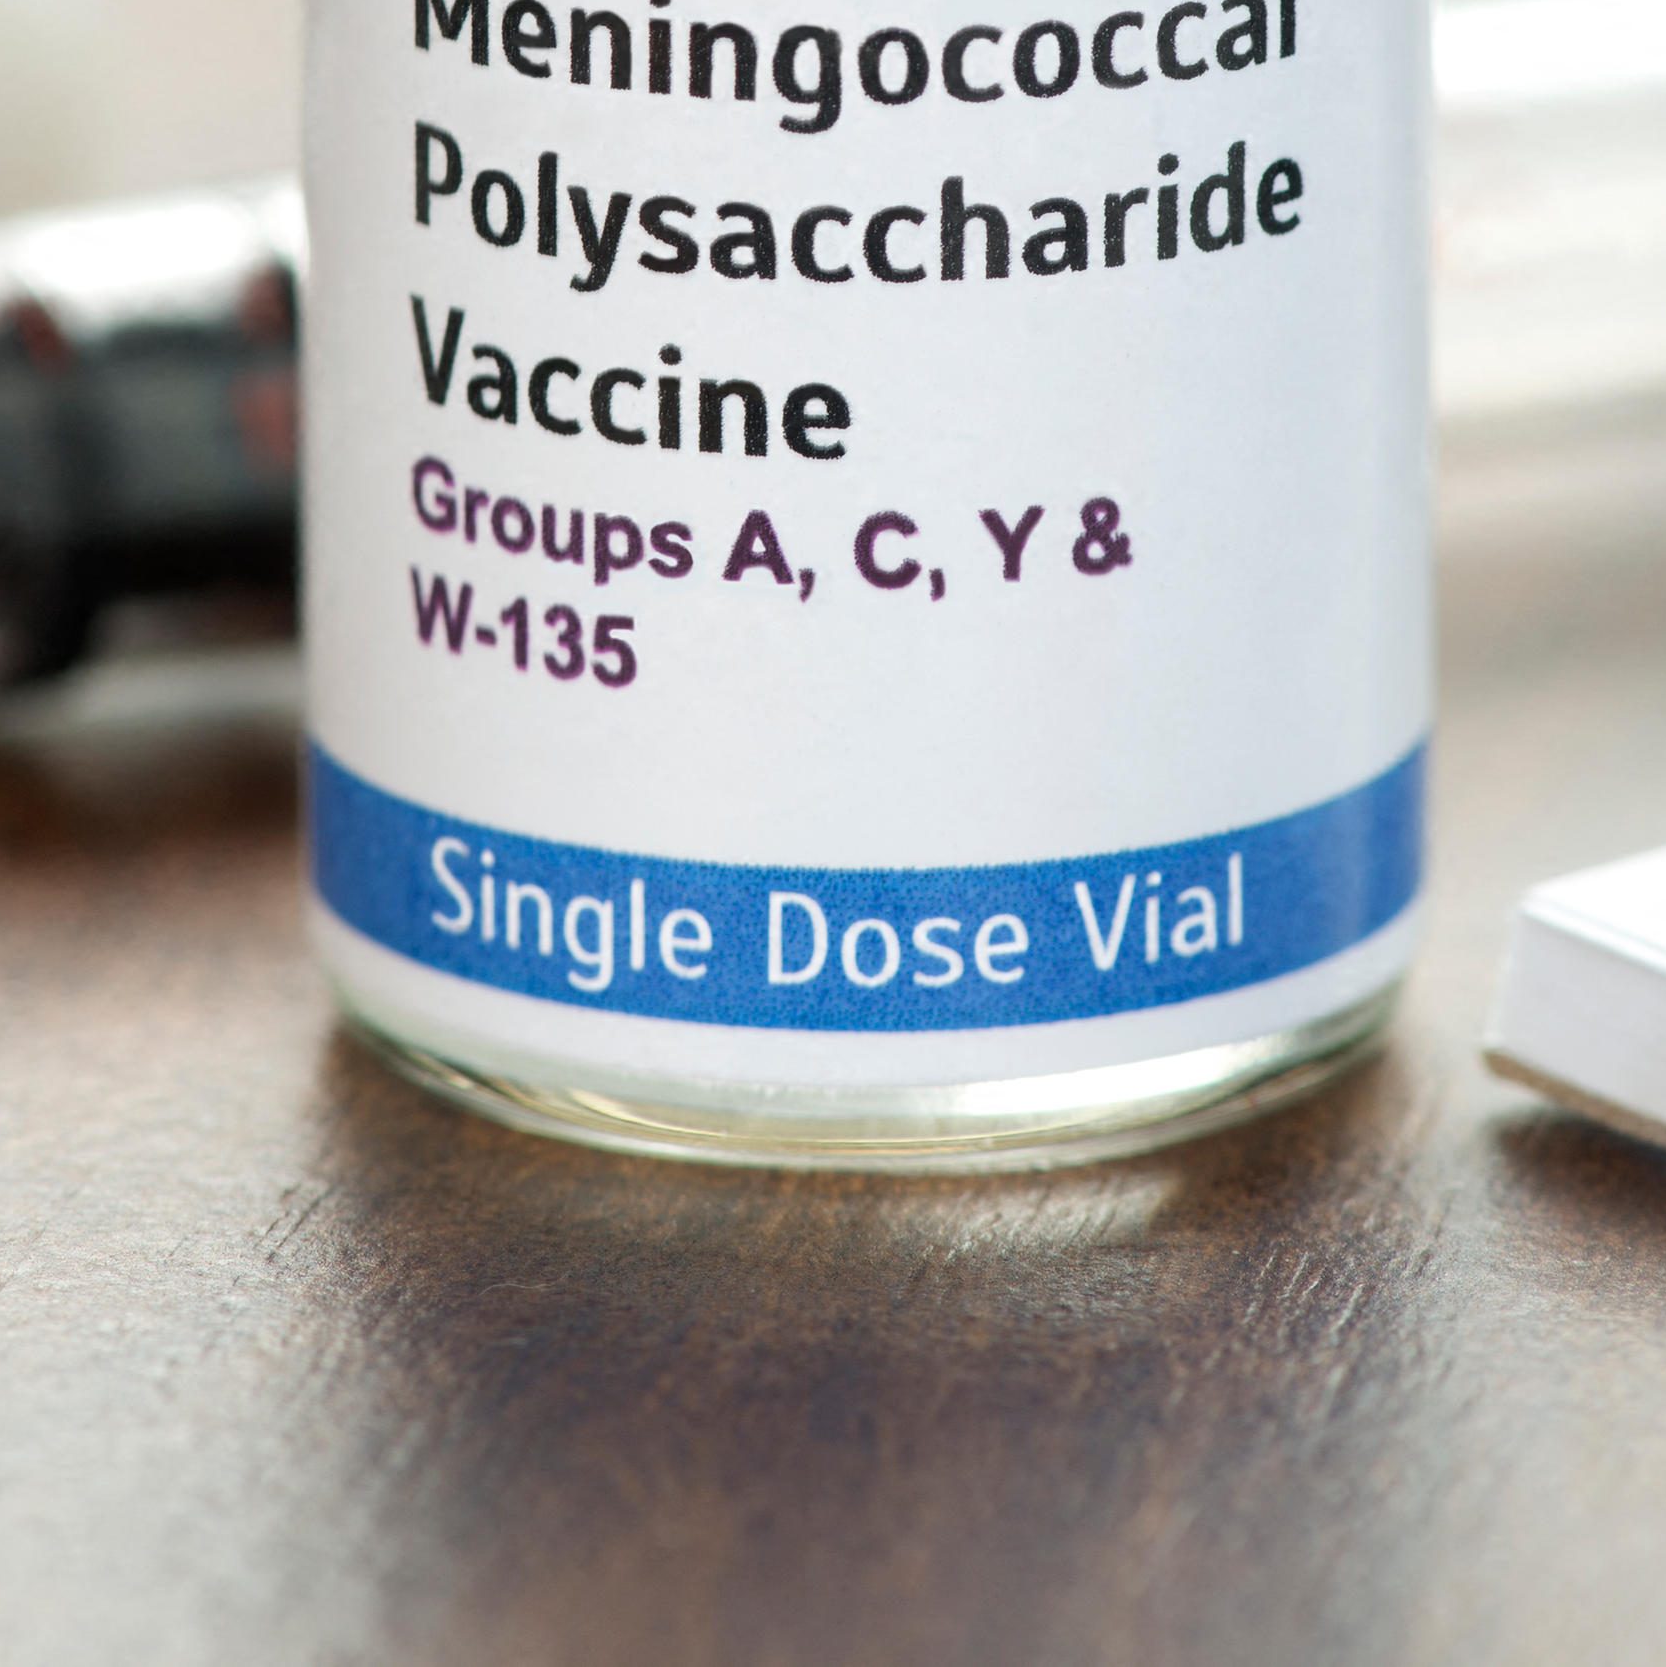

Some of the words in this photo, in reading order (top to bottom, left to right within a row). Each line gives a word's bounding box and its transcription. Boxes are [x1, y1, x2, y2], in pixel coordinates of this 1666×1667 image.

[411, 119, 1305, 293] Polysaccharide
[410, 294, 853, 461] Vaccine
[410, 455, 694, 586] Groups
[722, 509, 815, 602] A,
[853, 510, 947, 601] C,
[978, 505, 1044, 581] Y
[1071, 496, 1133, 576] &
[410, 564, 638, 688] W-135
[430, 836, 714, 994] Single
[766, 890, 1030, 988] Dose
[1073, 852, 1245, 973] Vial
